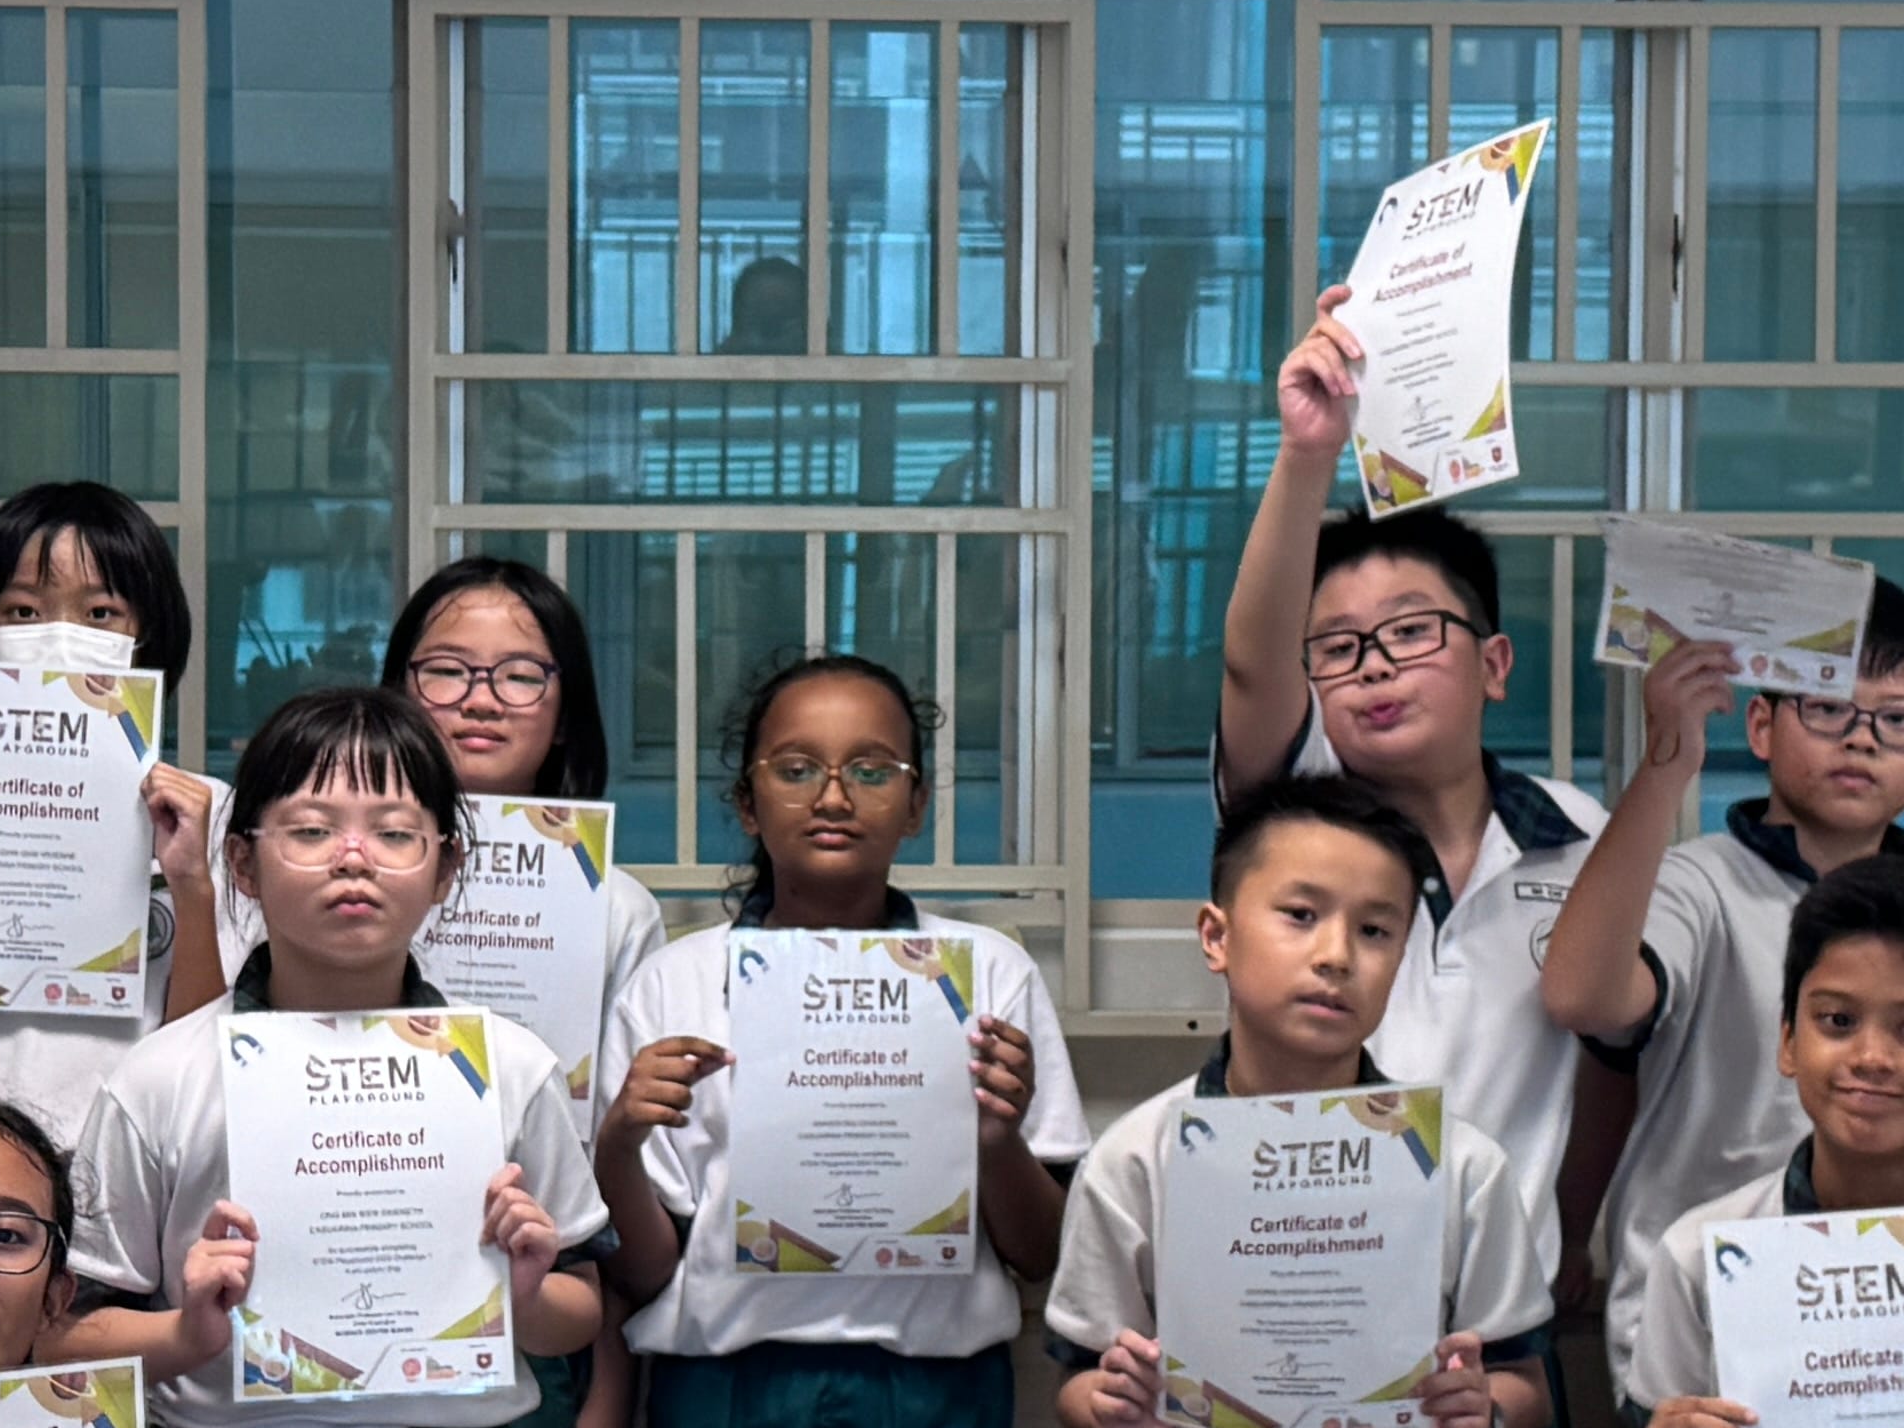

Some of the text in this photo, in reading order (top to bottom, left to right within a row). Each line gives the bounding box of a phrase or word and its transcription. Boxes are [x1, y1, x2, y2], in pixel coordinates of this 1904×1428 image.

[1406, 178, 1484, 230] STEM
[1389, 241, 1466, 280] Certificate of
[1373, 261, 1473, 304] Accomplishment
[68, 782, 84, 799] of
[470, 841, 545, 875] TEM
[440, 906, 540, 927] Certificate of
[423, 927, 555, 951] Accomplishment
[802, 974, 909, 1012] STEM
[804, 1014, 911, 1024] PLAYGROUND
[803, 1049, 909, 1066] Certificate of
[305, 1053, 421, 1091] STEM
[787, 1071, 924, 1090] Accomplishment
[308, 1091, 425, 1105] PLAYGROUND
[311, 1127, 425, 1150] Certificate of
[295, 1152, 445, 1177] Accomplishment
[1252, 1137, 1372, 1179] STEM
[1253, 1175, 1372, 1192] PLAYGROUND
[1249, 1211, 1368, 1235] Certificate of
[1229, 1235, 1384, 1257] Accomplishment
[1804, 1345, 1904, 1372] Certificate
